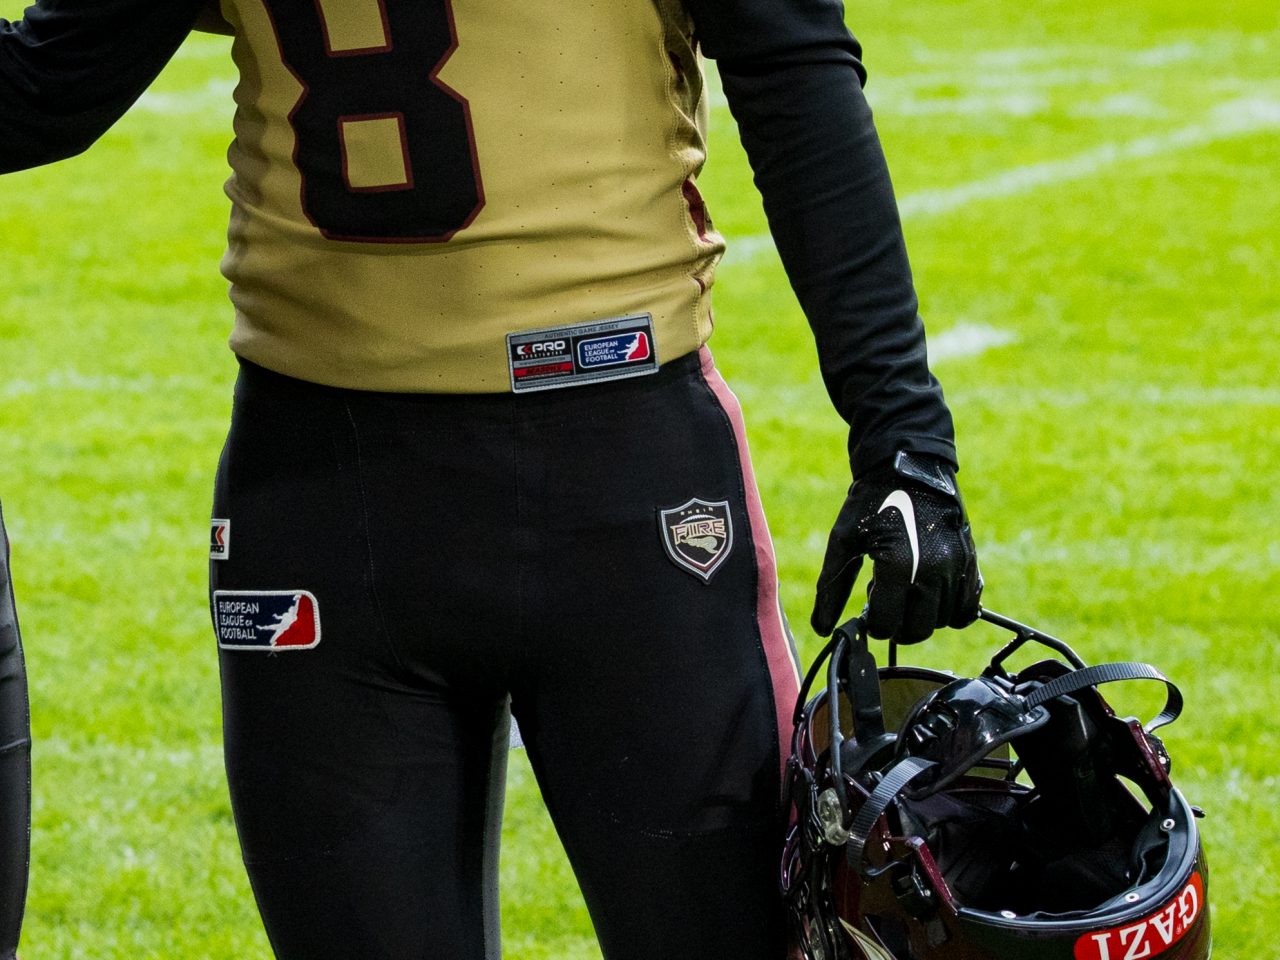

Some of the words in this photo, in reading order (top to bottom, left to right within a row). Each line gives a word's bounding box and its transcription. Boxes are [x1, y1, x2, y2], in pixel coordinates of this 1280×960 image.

[583, 340, 619, 351] EUROPEAN
[584, 349, 610, 357] LEAGUE
[585, 353, 619, 363] FOOTBALL
[670, 518, 727, 545] FIRE
[219, 601, 260, 614] EUROPEAN
[220, 614, 245, 627] LEAGUE
[221, 628, 257, 640] FOOTBALL
[1091, 883, 1198, 960] GAZI
